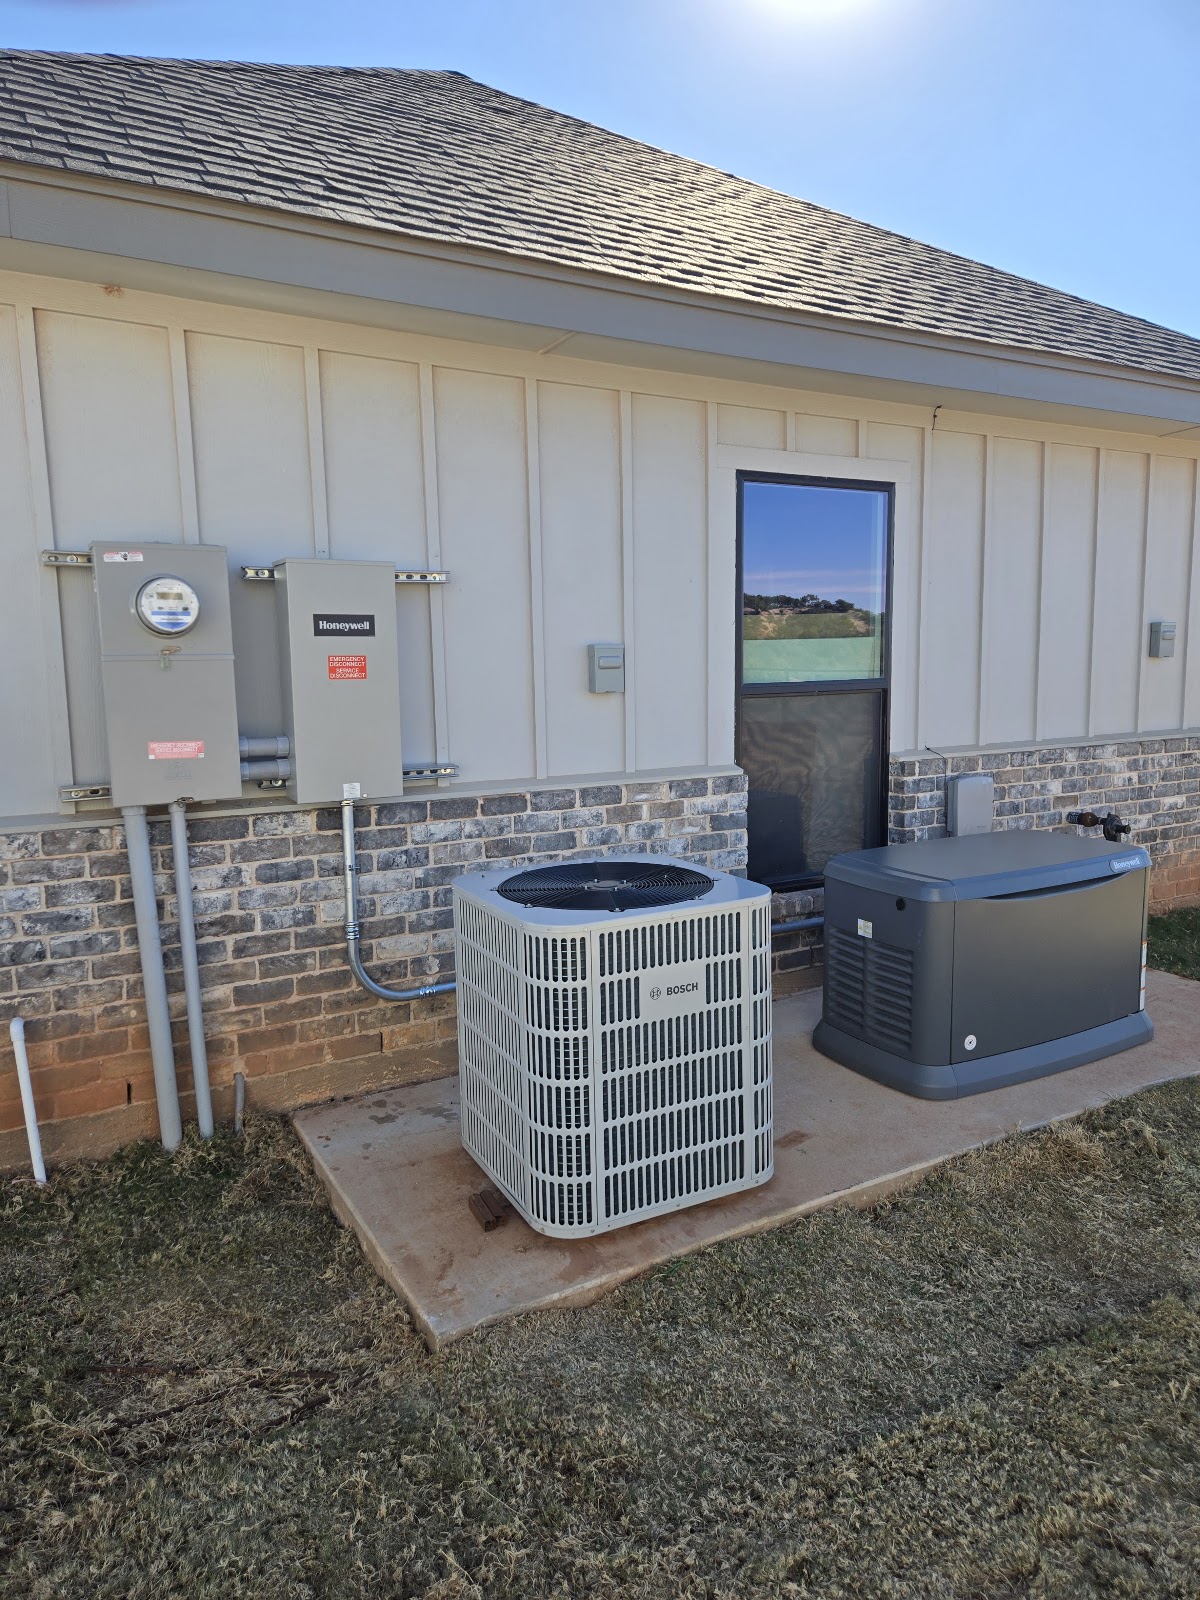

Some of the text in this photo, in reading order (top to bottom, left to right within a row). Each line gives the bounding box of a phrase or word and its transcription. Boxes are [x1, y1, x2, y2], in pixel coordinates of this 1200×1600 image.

[319, 620, 369, 631] Honeywell
[1113, 857, 1140, 869] Honeywell
[666, 982, 698, 995] BOSCH
